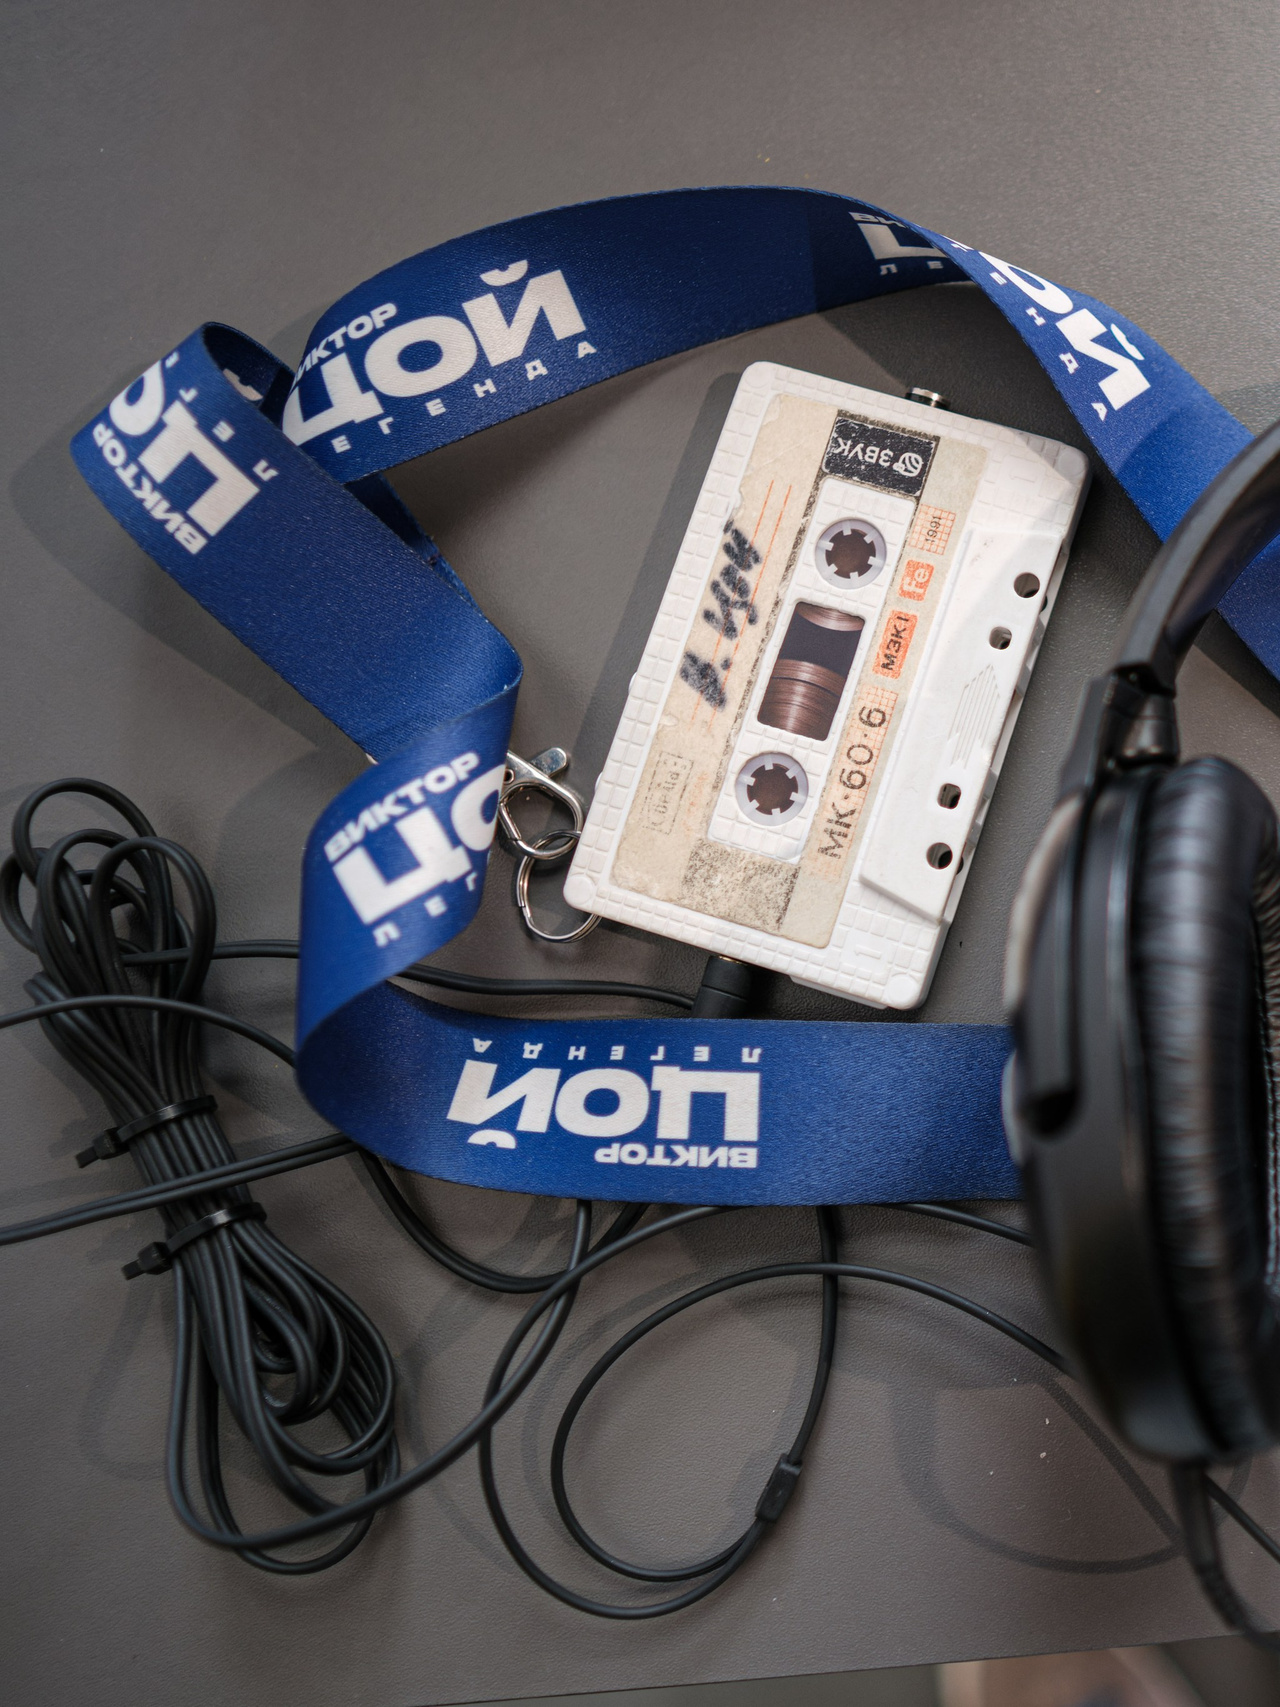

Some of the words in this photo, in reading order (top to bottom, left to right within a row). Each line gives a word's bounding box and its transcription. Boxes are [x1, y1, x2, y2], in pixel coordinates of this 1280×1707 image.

[282, 259, 587, 447] ЦОЙ
[291, 302, 398, 390] ИКТОР
[942, 235, 1151, 411] ОЙ
[109, 360, 260, 536] ЦО
[331, 341, 597, 454] ЕГЕНДА
[833, 437, 894, 467] ЗВУК
[92, 422, 208, 555] ВИКТОР
[925, 515, 943, 543] 1991
[324, 752, 480, 863] ВИКТОР
[332, 764, 506, 925] ЦО
[446, 1059, 760, 1149] ЦОЙ
[473, 1038, 762, 1063] ЛЕГЕНДА
[594, 1142, 758, 1168] ВИКТОР
